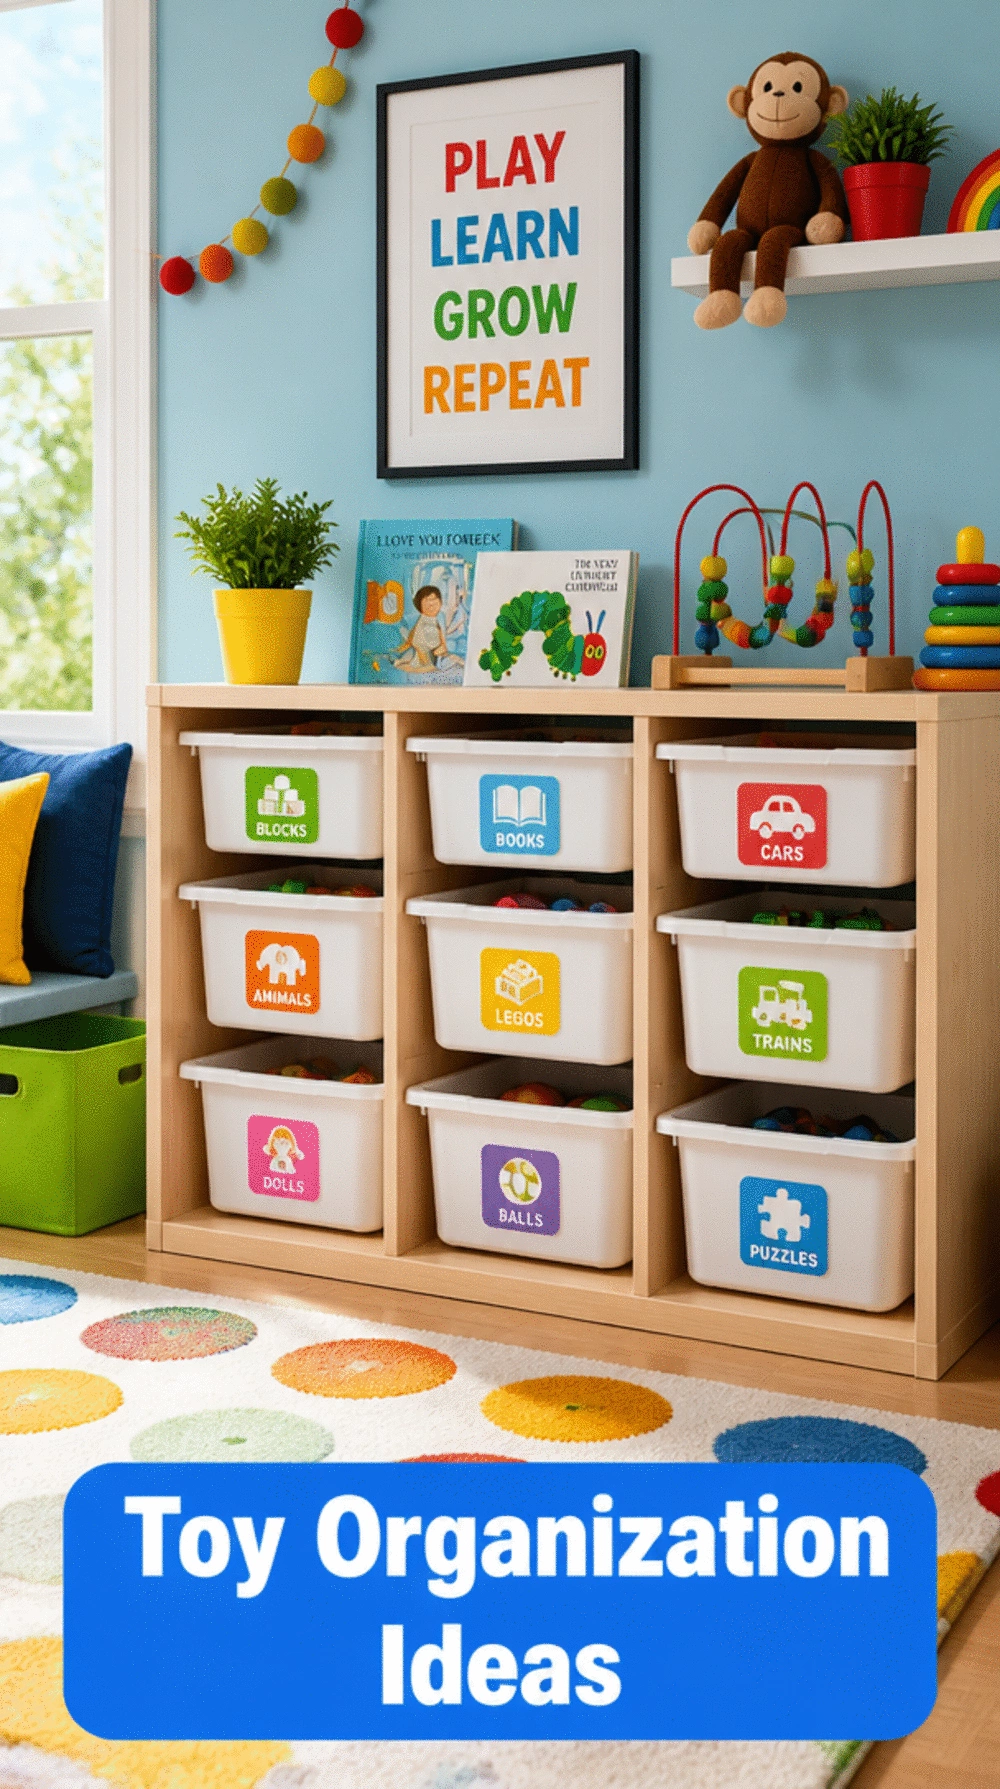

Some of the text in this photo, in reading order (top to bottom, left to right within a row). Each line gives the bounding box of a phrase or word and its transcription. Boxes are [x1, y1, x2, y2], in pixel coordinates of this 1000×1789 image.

[445, 131, 566, 193] PLAY
[431, 205, 579, 267] LEARN
[433, 282, 578, 341] GROW
[423, 356, 590, 414] REPEAT
[383, 535, 415, 547] LOVE
[419, 534, 443, 547] YOU
[256, 821, 307, 838] BLOCKS
[496, 833, 545, 849] BOOKS
[760, 844, 805, 862] CARS
[252, 989, 312, 1007] ANIMALS
[495, 1007, 544, 1028] LEGOS
[752, 1033, 813, 1054] TRAINS
[263, 1176, 305, 1194] DOLLS
[498, 1208, 544, 1228] BALLS
[749, 1243, 818, 1268] PUZZLES
